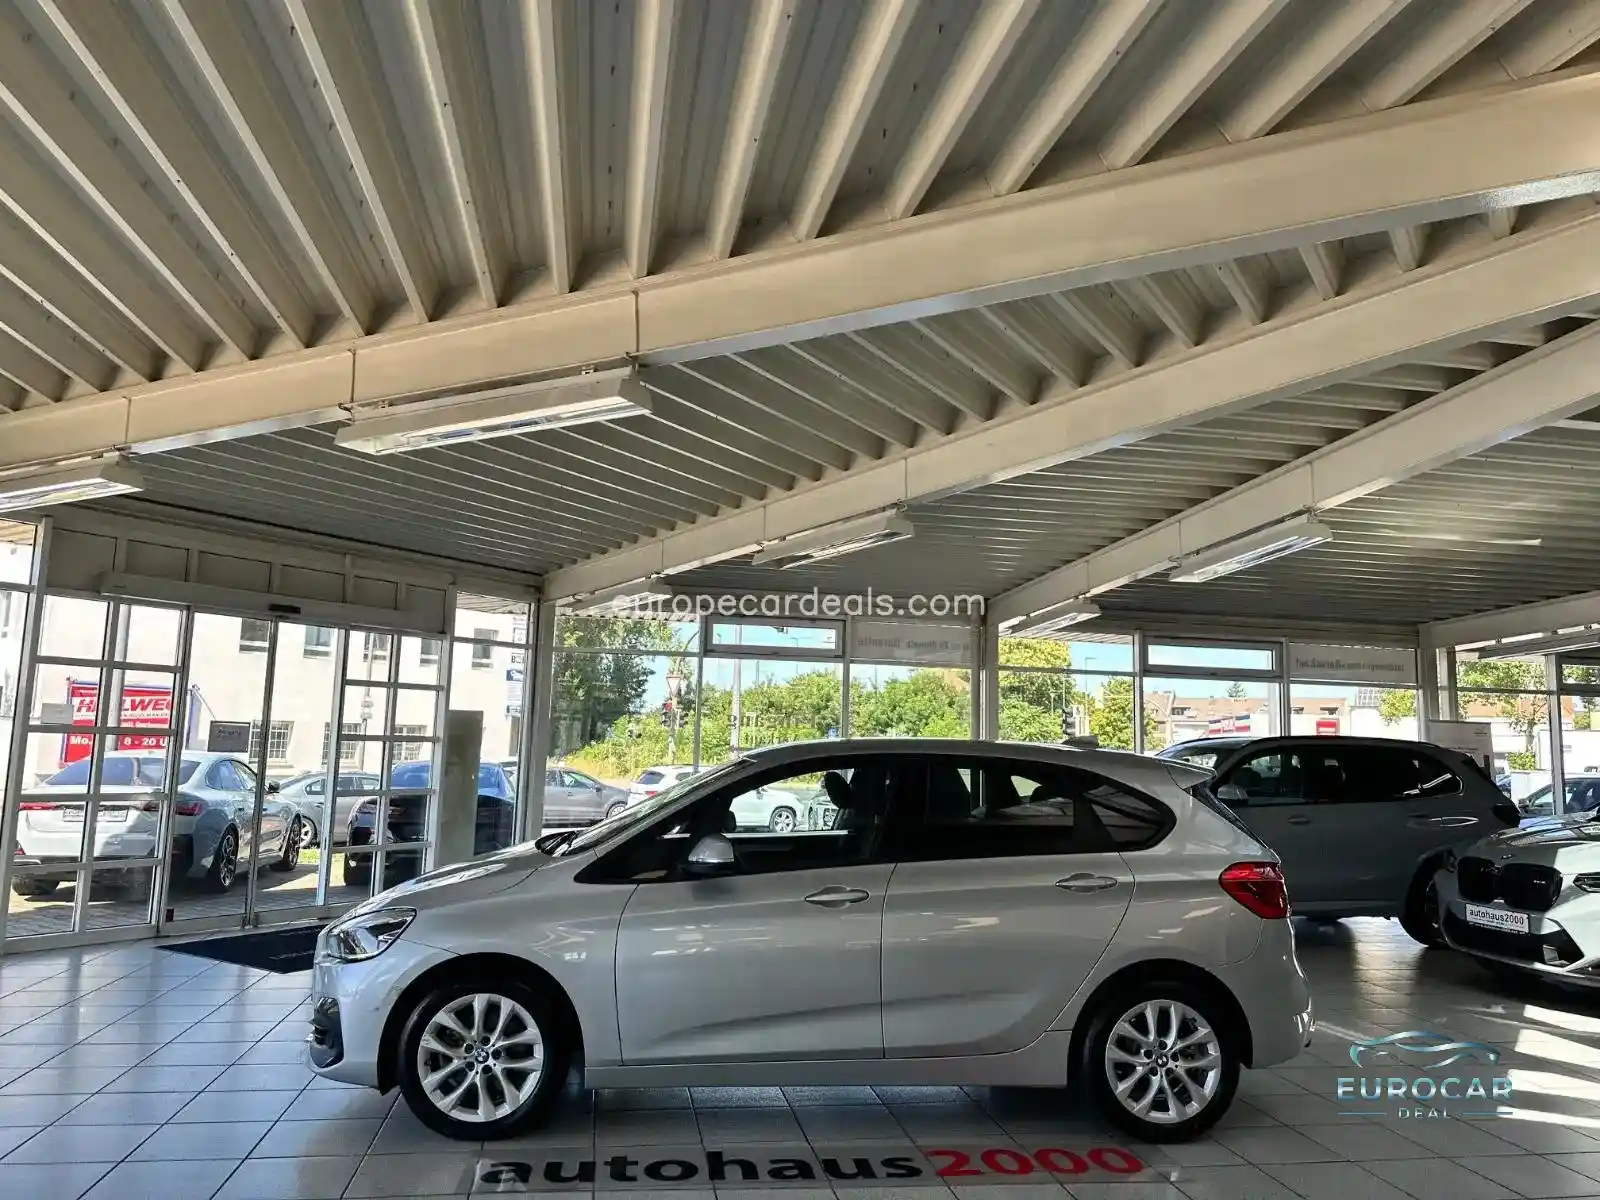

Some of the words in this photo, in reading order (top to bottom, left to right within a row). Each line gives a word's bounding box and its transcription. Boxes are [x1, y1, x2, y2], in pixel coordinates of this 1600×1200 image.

[124, 737, 132, 746] 8
[143, 737, 157, 746] 20
[1470, 909, 1524, 925] autohaus2000
[480, 1148, 1143, 1184] autohaus2000
